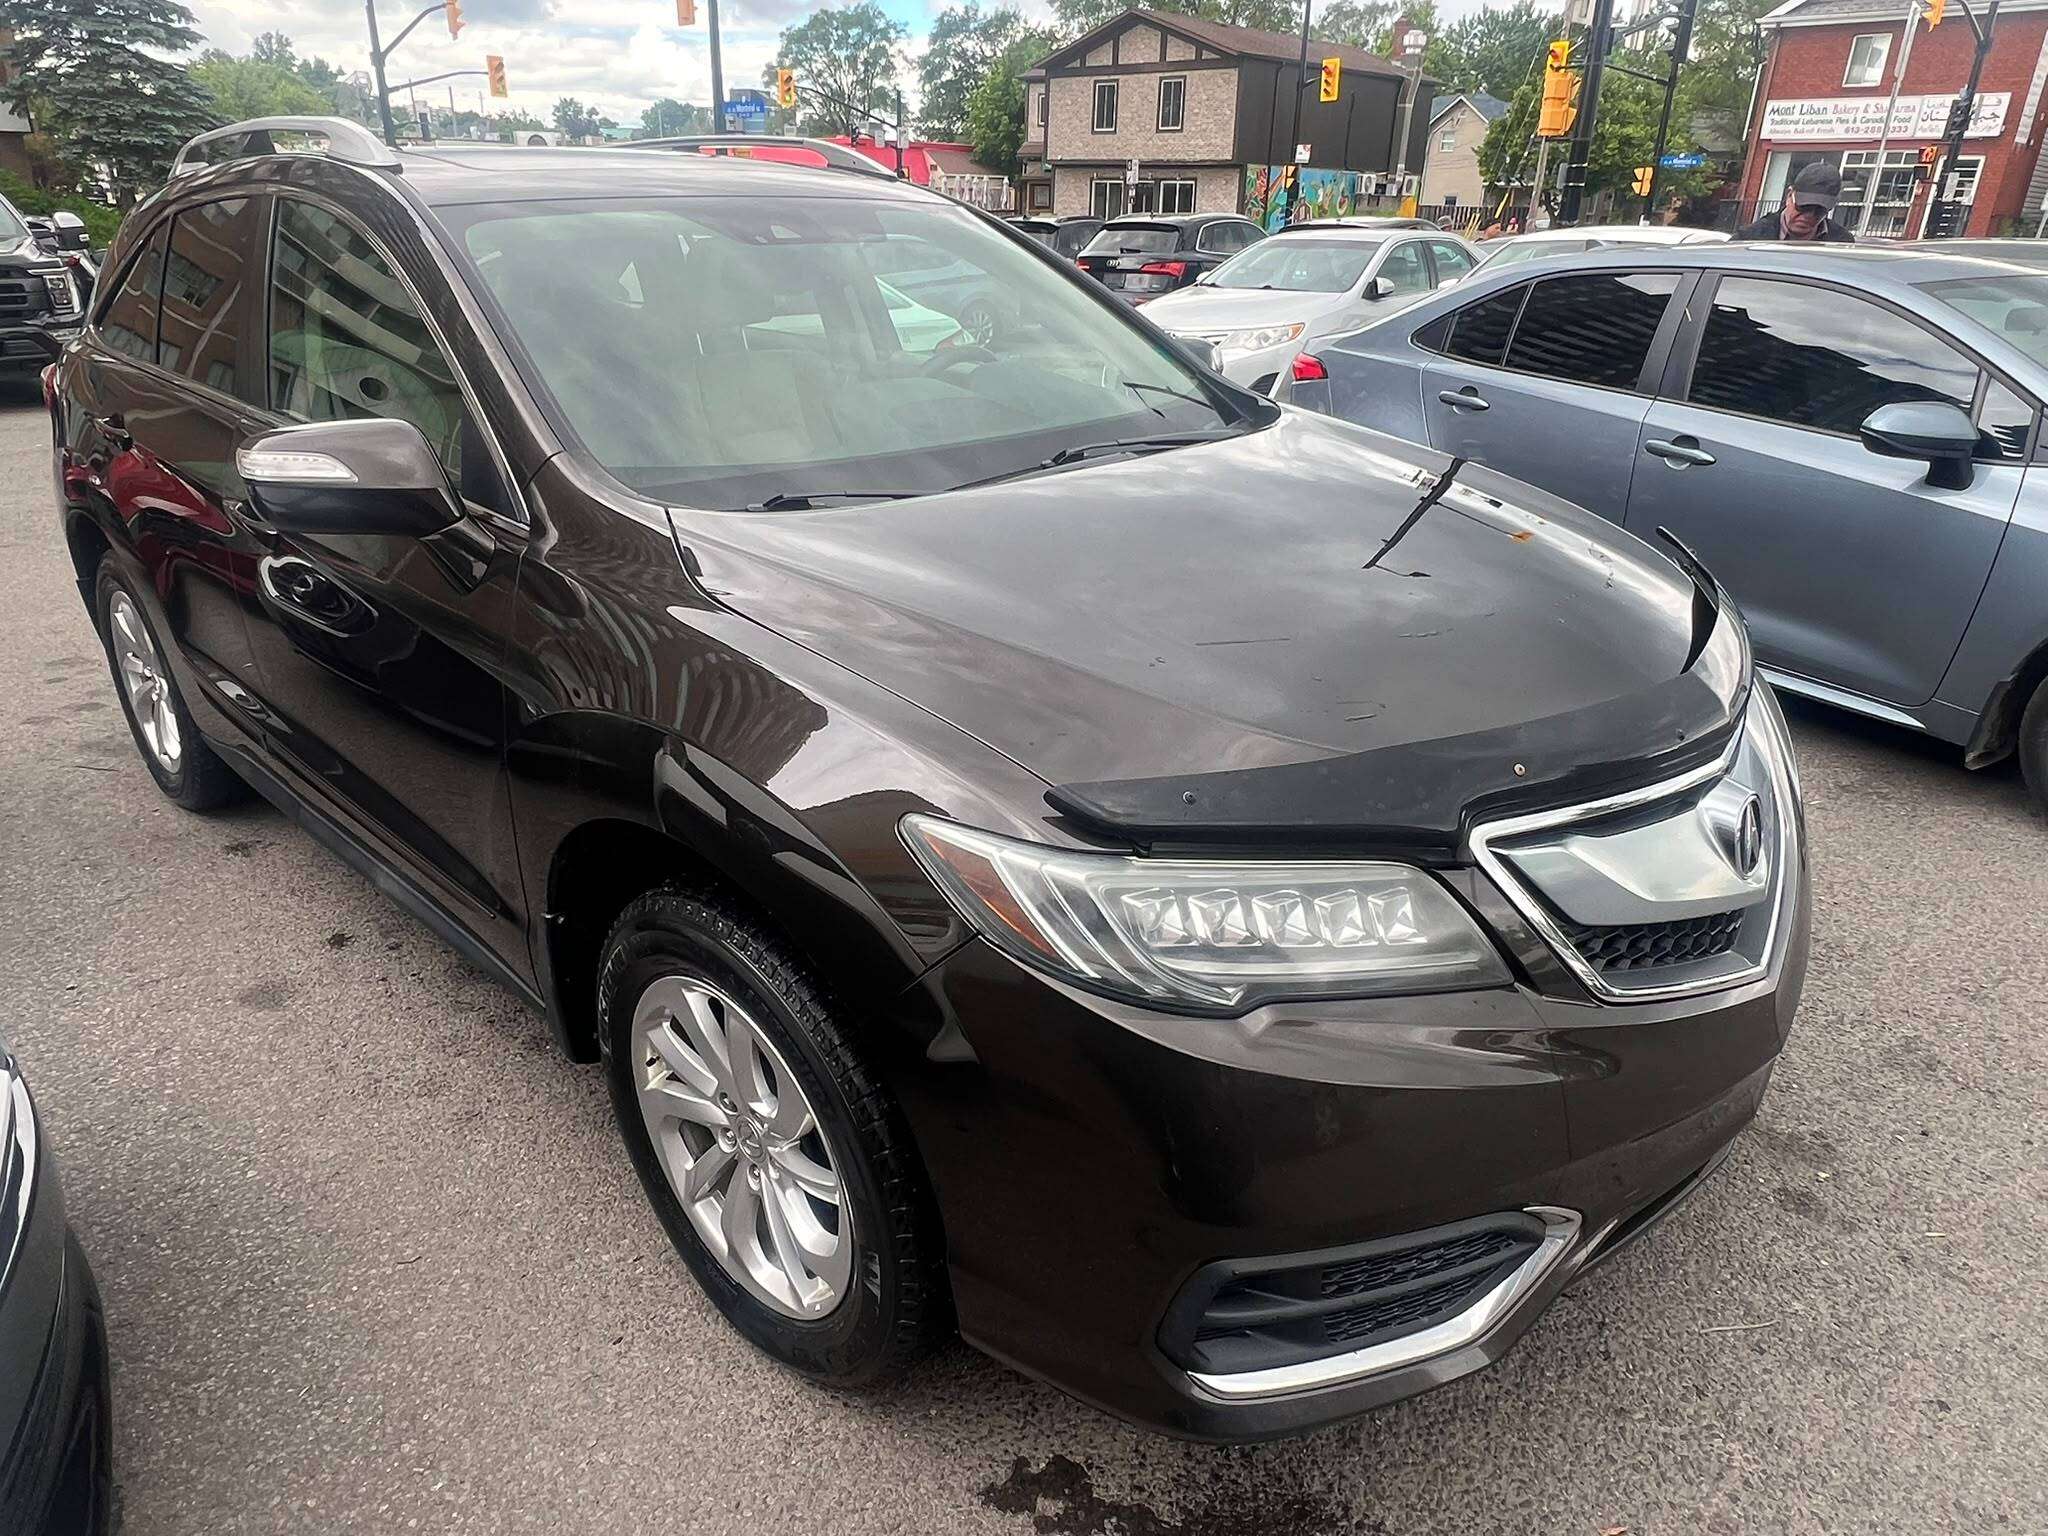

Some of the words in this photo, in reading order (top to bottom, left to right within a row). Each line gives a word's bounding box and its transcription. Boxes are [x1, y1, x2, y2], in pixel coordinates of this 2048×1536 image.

[1768, 104, 1796, 116] Mont
[1799, 103, 1828, 116] Liban
[1832, 103, 1860, 115] Bakery
[1873, 103, 1917, 114] Shaarma
[1893, 115, 1912, 124] Food
